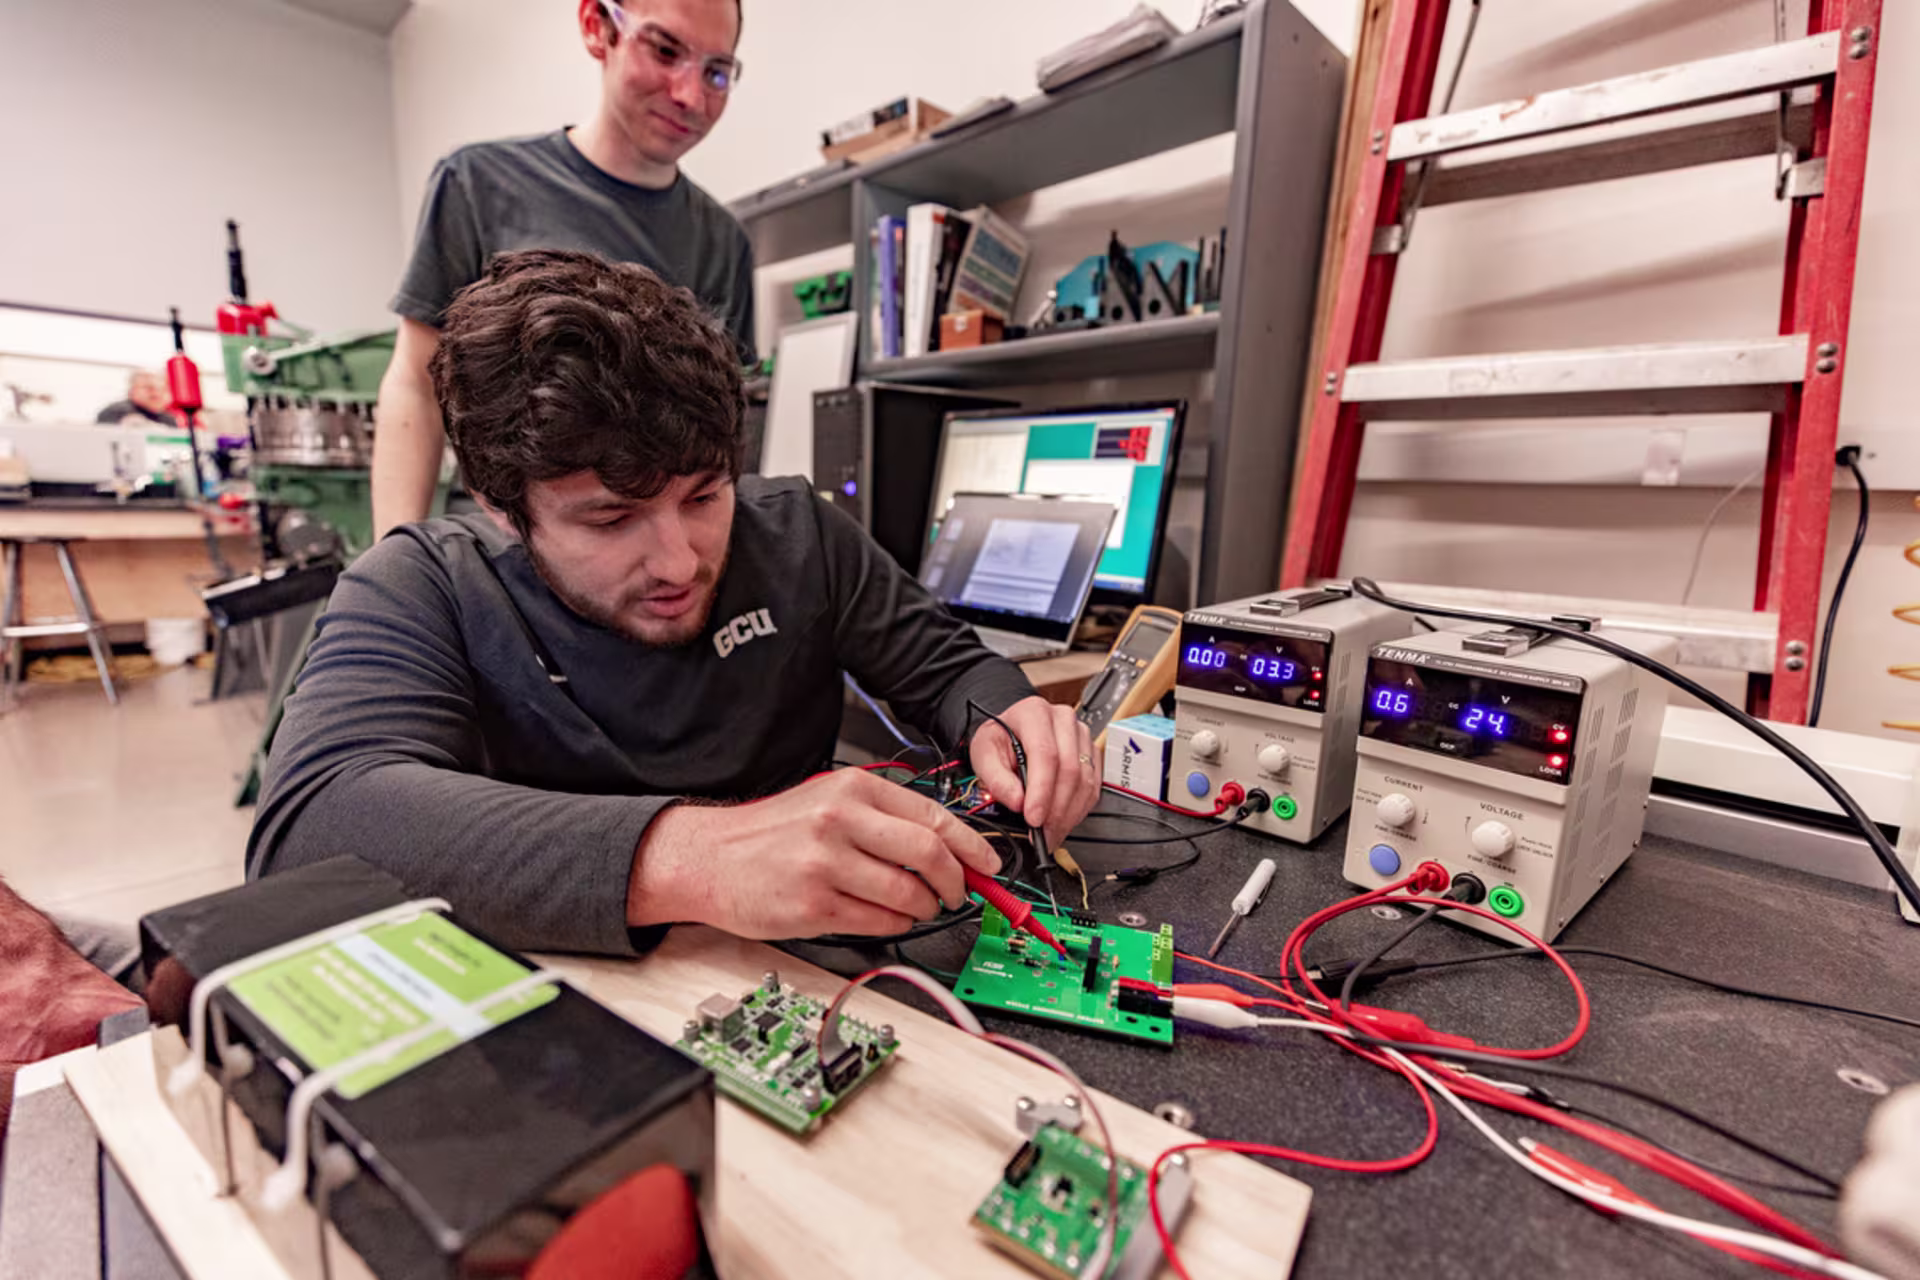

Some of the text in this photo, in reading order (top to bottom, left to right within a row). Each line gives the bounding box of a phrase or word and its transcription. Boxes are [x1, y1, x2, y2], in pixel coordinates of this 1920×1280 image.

[1187, 613, 1225, 625] TENMA
[713, 608, 777, 658] GCU
[1208, 635, 1215, 643] A
[1276, 646, 1283, 654] V
[1376, 648, 1427, 664] TENMA
[1405, 677, 1414, 686] A
[1376, 690, 1409, 713] 0.6
[1501, 695, 1510, 704] V
[1539, 765, 1562, 776] LOCK
[1384, 775, 1424, 792] CURRENT
[1480, 802, 1525, 820] VOLTAGE
